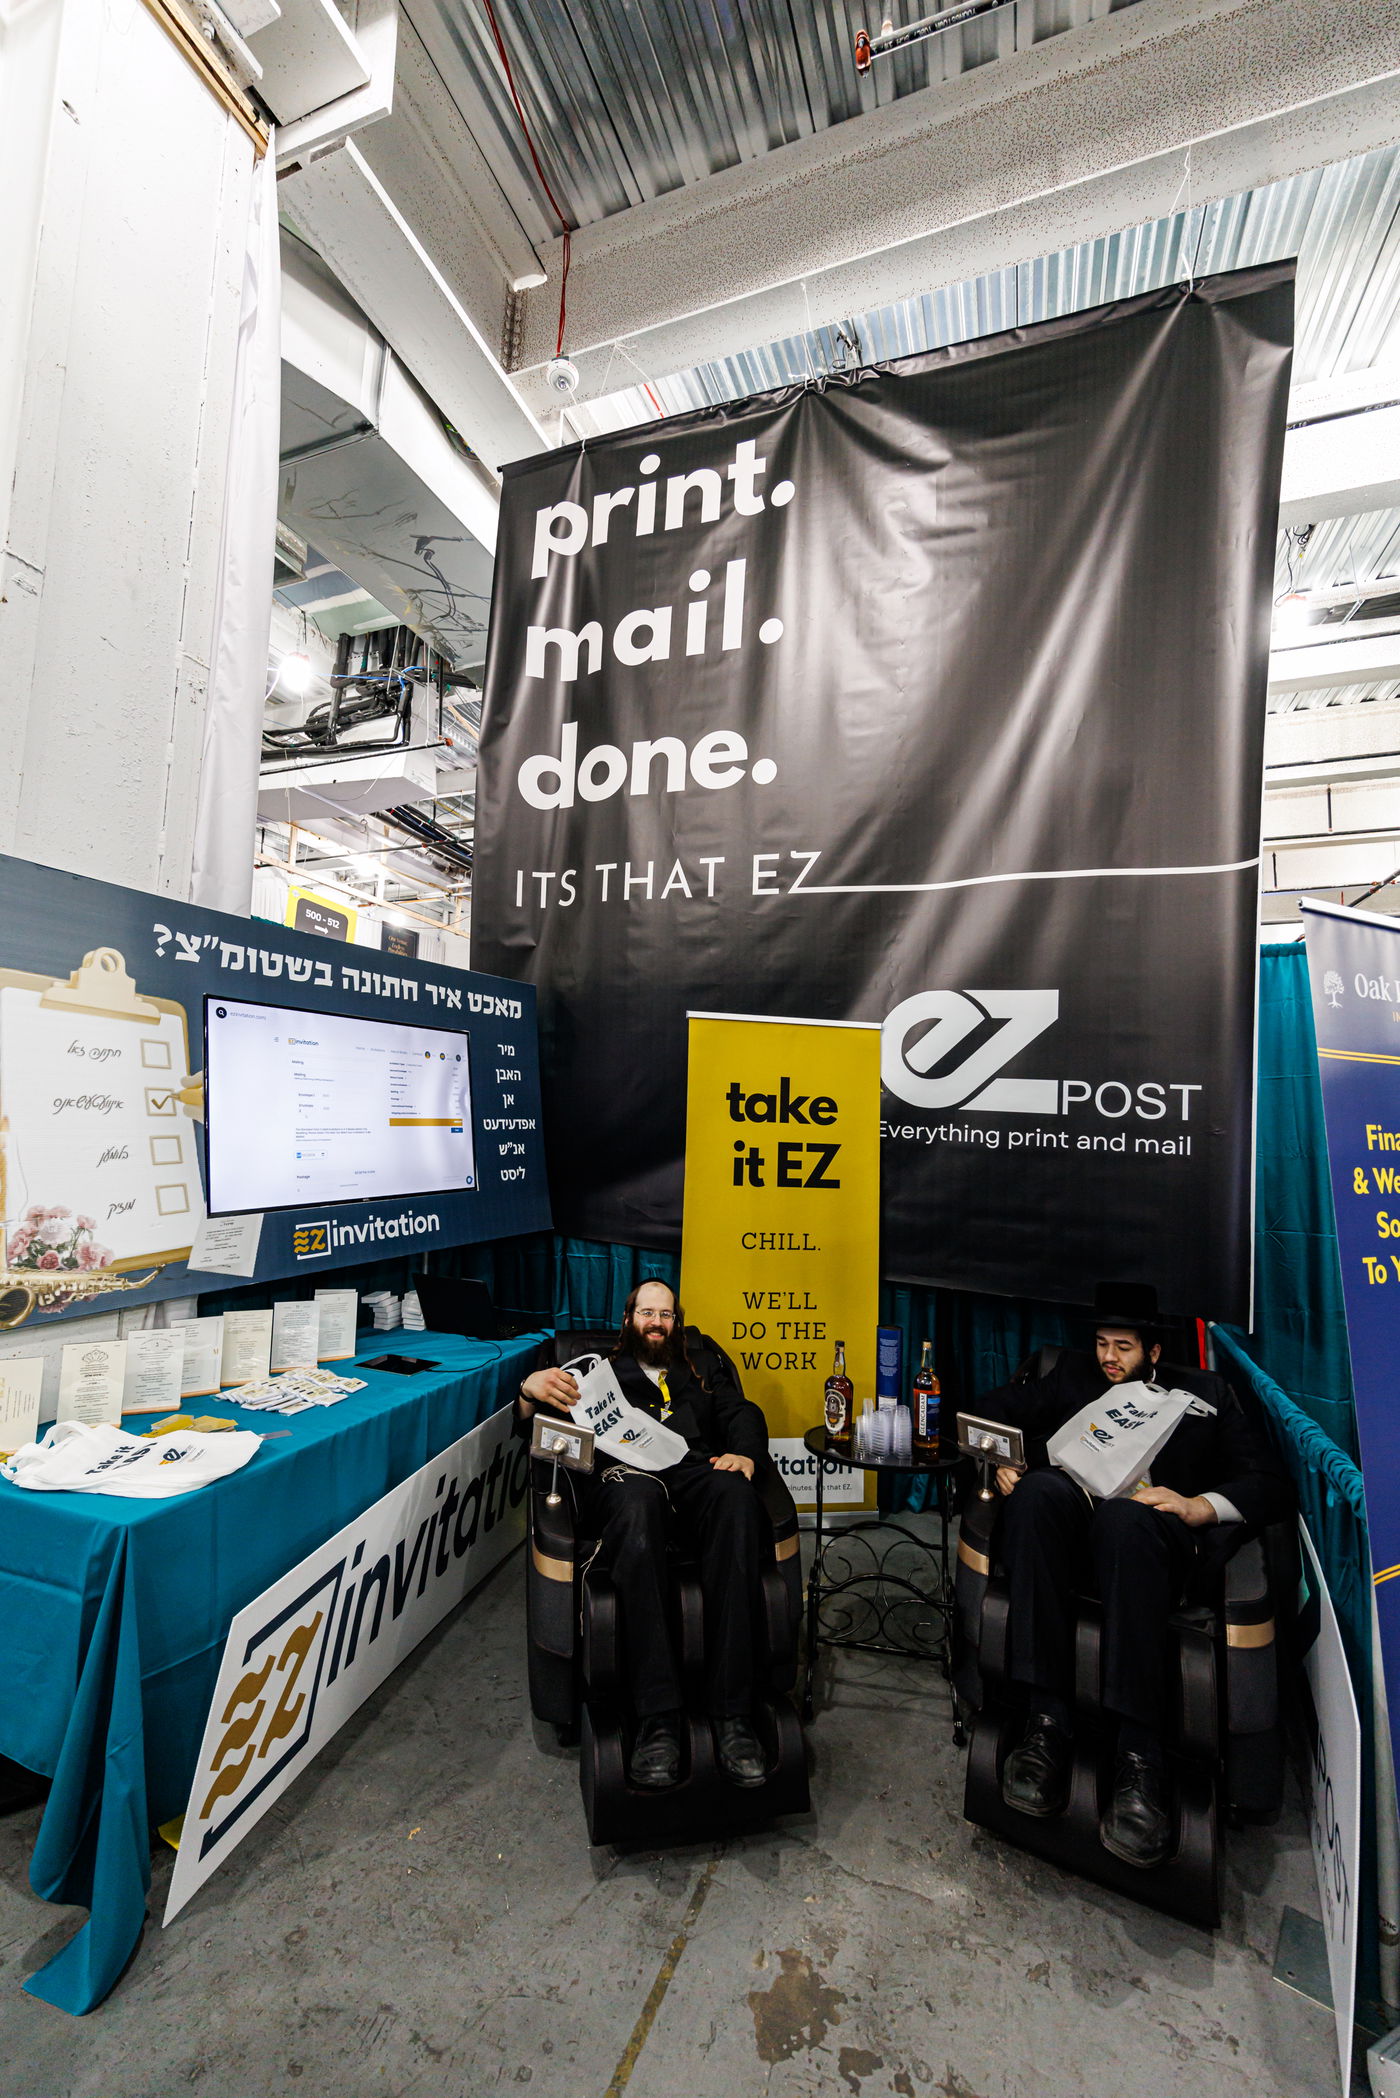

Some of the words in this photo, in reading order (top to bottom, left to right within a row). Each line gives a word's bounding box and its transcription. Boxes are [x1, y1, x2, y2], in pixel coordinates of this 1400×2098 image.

[531, 439, 796, 579] print.
[525, 558, 784, 682] mail.
[517, 721, 777, 811] done.
[516, 869, 577, 908] ITS
[595, 857, 725, 902] THAT
[752, 850, 822, 895] EZ
[305, 908, 321, 922] 500
[327, 917, 340, 929] 512
[341, 966, 418, 1001] חתונה
[425, 982, 462, 1010] איר
[1354, 973, 1392, 1002] Oak
[497, 1044, 515, 1056] מיר
[495, 1068, 521, 1083] האבן
[502, 1094, 514, 1108] אן
[726, 1076, 838, 1125] take
[1062, 1080, 1203, 1121] POST
[880, 1121, 1000, 1149] Everything
[1008, 1128, 1069, 1149] print
[1077, 1132, 1126, 1152] and
[1135, 1136, 1191, 1155] mail
[500, 1166, 526, 1181] ליסט
[733, 1139, 765, 1187] it
[777, 1141, 842, 1189] EZ
[1353, 1167, 1369, 1194] &
[293, 1228, 326, 1254] EZ
[332, 1210, 440, 1247] invitation
[741, 1232, 821, 1251] CHILL.
[1362, 1256, 1388, 1285] To
[742, 1291, 817, 1310] WE'LL
[732, 1321, 766, 1340] DO
[777, 1321, 826, 1340] THE
[740, 1352, 817, 1370] WORK
[585, 1400, 608, 1420] Take
[606, 1390, 616, 1402] it
[1105, 1408, 1145, 1430] EASY
[593, 1407, 624, 1437] EASY
[826, 1483, 841, 1491] that
[1318, 1731, 1350, 1945] POST
